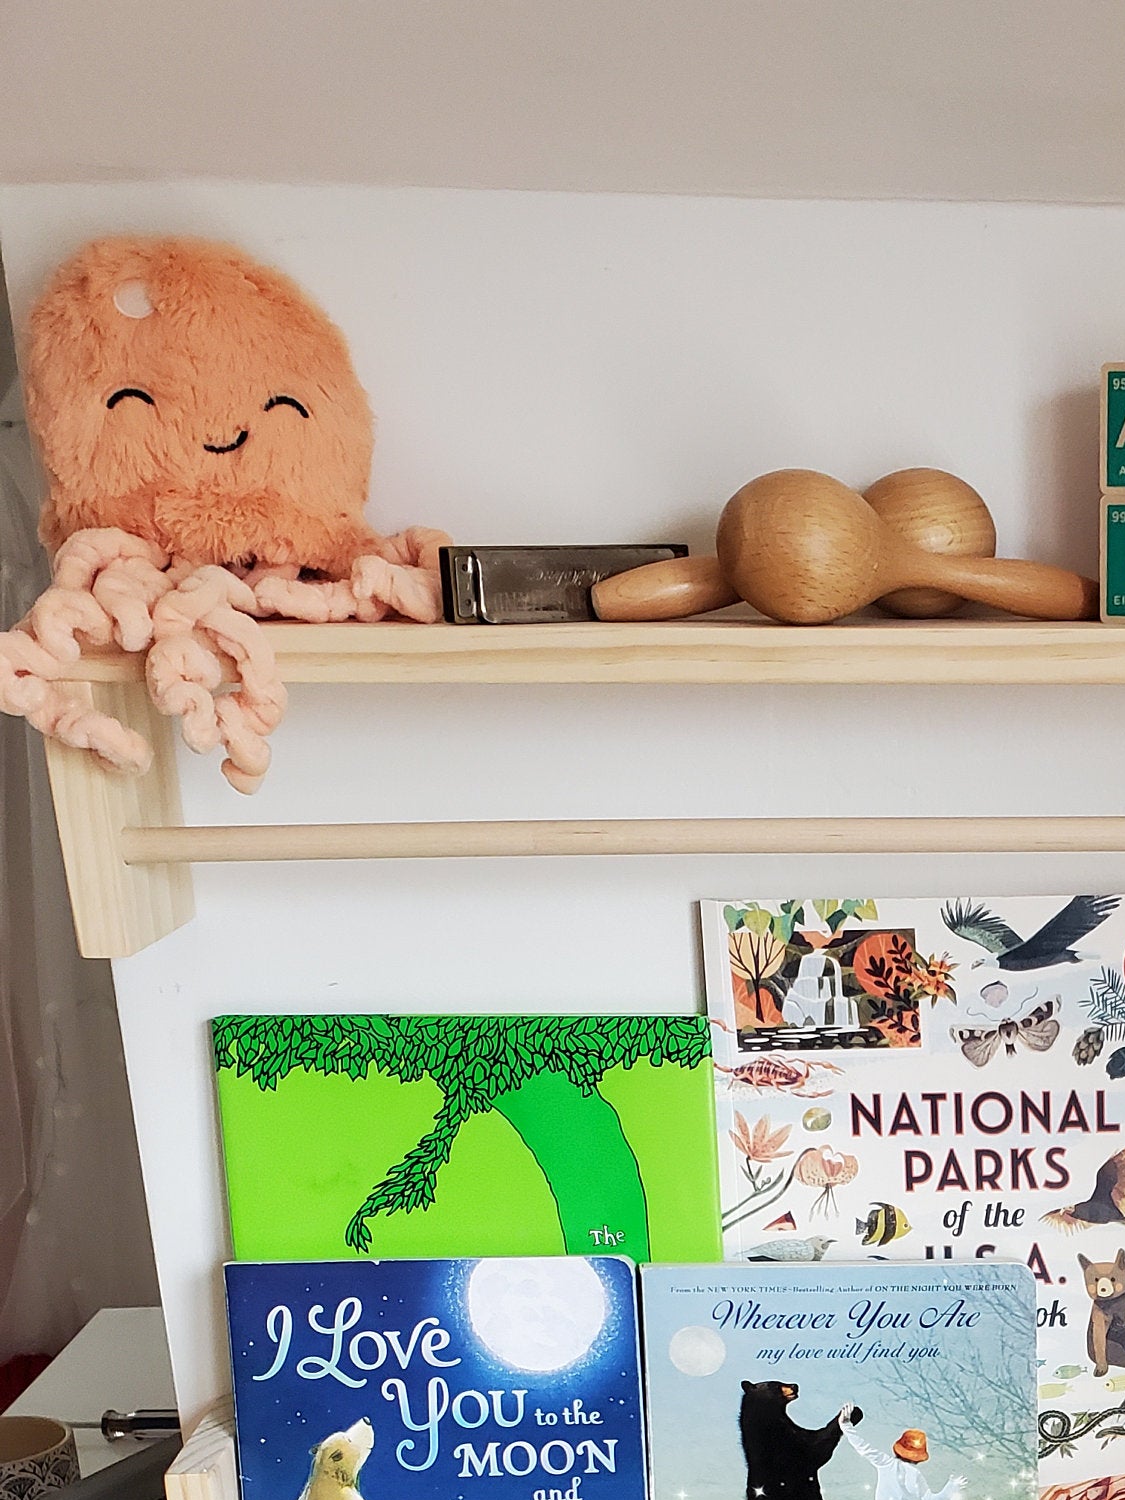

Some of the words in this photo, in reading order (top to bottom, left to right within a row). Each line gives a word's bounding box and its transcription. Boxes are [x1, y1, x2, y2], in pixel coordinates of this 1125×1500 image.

[850, 1088, 1120, 1137] NATIONAL
[904, 1146, 1070, 1193] PARKS
[588, 1224, 626, 1247] The
[943, 1202, 972, 1236] of
[984, 1202, 1025, 1228] the
[712, 1300, 838, 1330] Wherever
[847, 1300, 912, 1340] You
[919, 1300, 981, 1330] Are
[252, 1304, 293, 1382] I
[296, 1296, 462, 1389] Love
[757, 1346, 784, 1364] my
[789, 1343, 824, 1360] love
[827, 1342, 860, 1360] will
[862, 1340, 903, 1364] find
[908, 1348, 941, 1364] you
[381, 1376, 530, 1472] You
[534, 1408, 558, 1426] to
[562, 1400, 604, 1426] the
[453, 1438, 618, 1478] MOON
